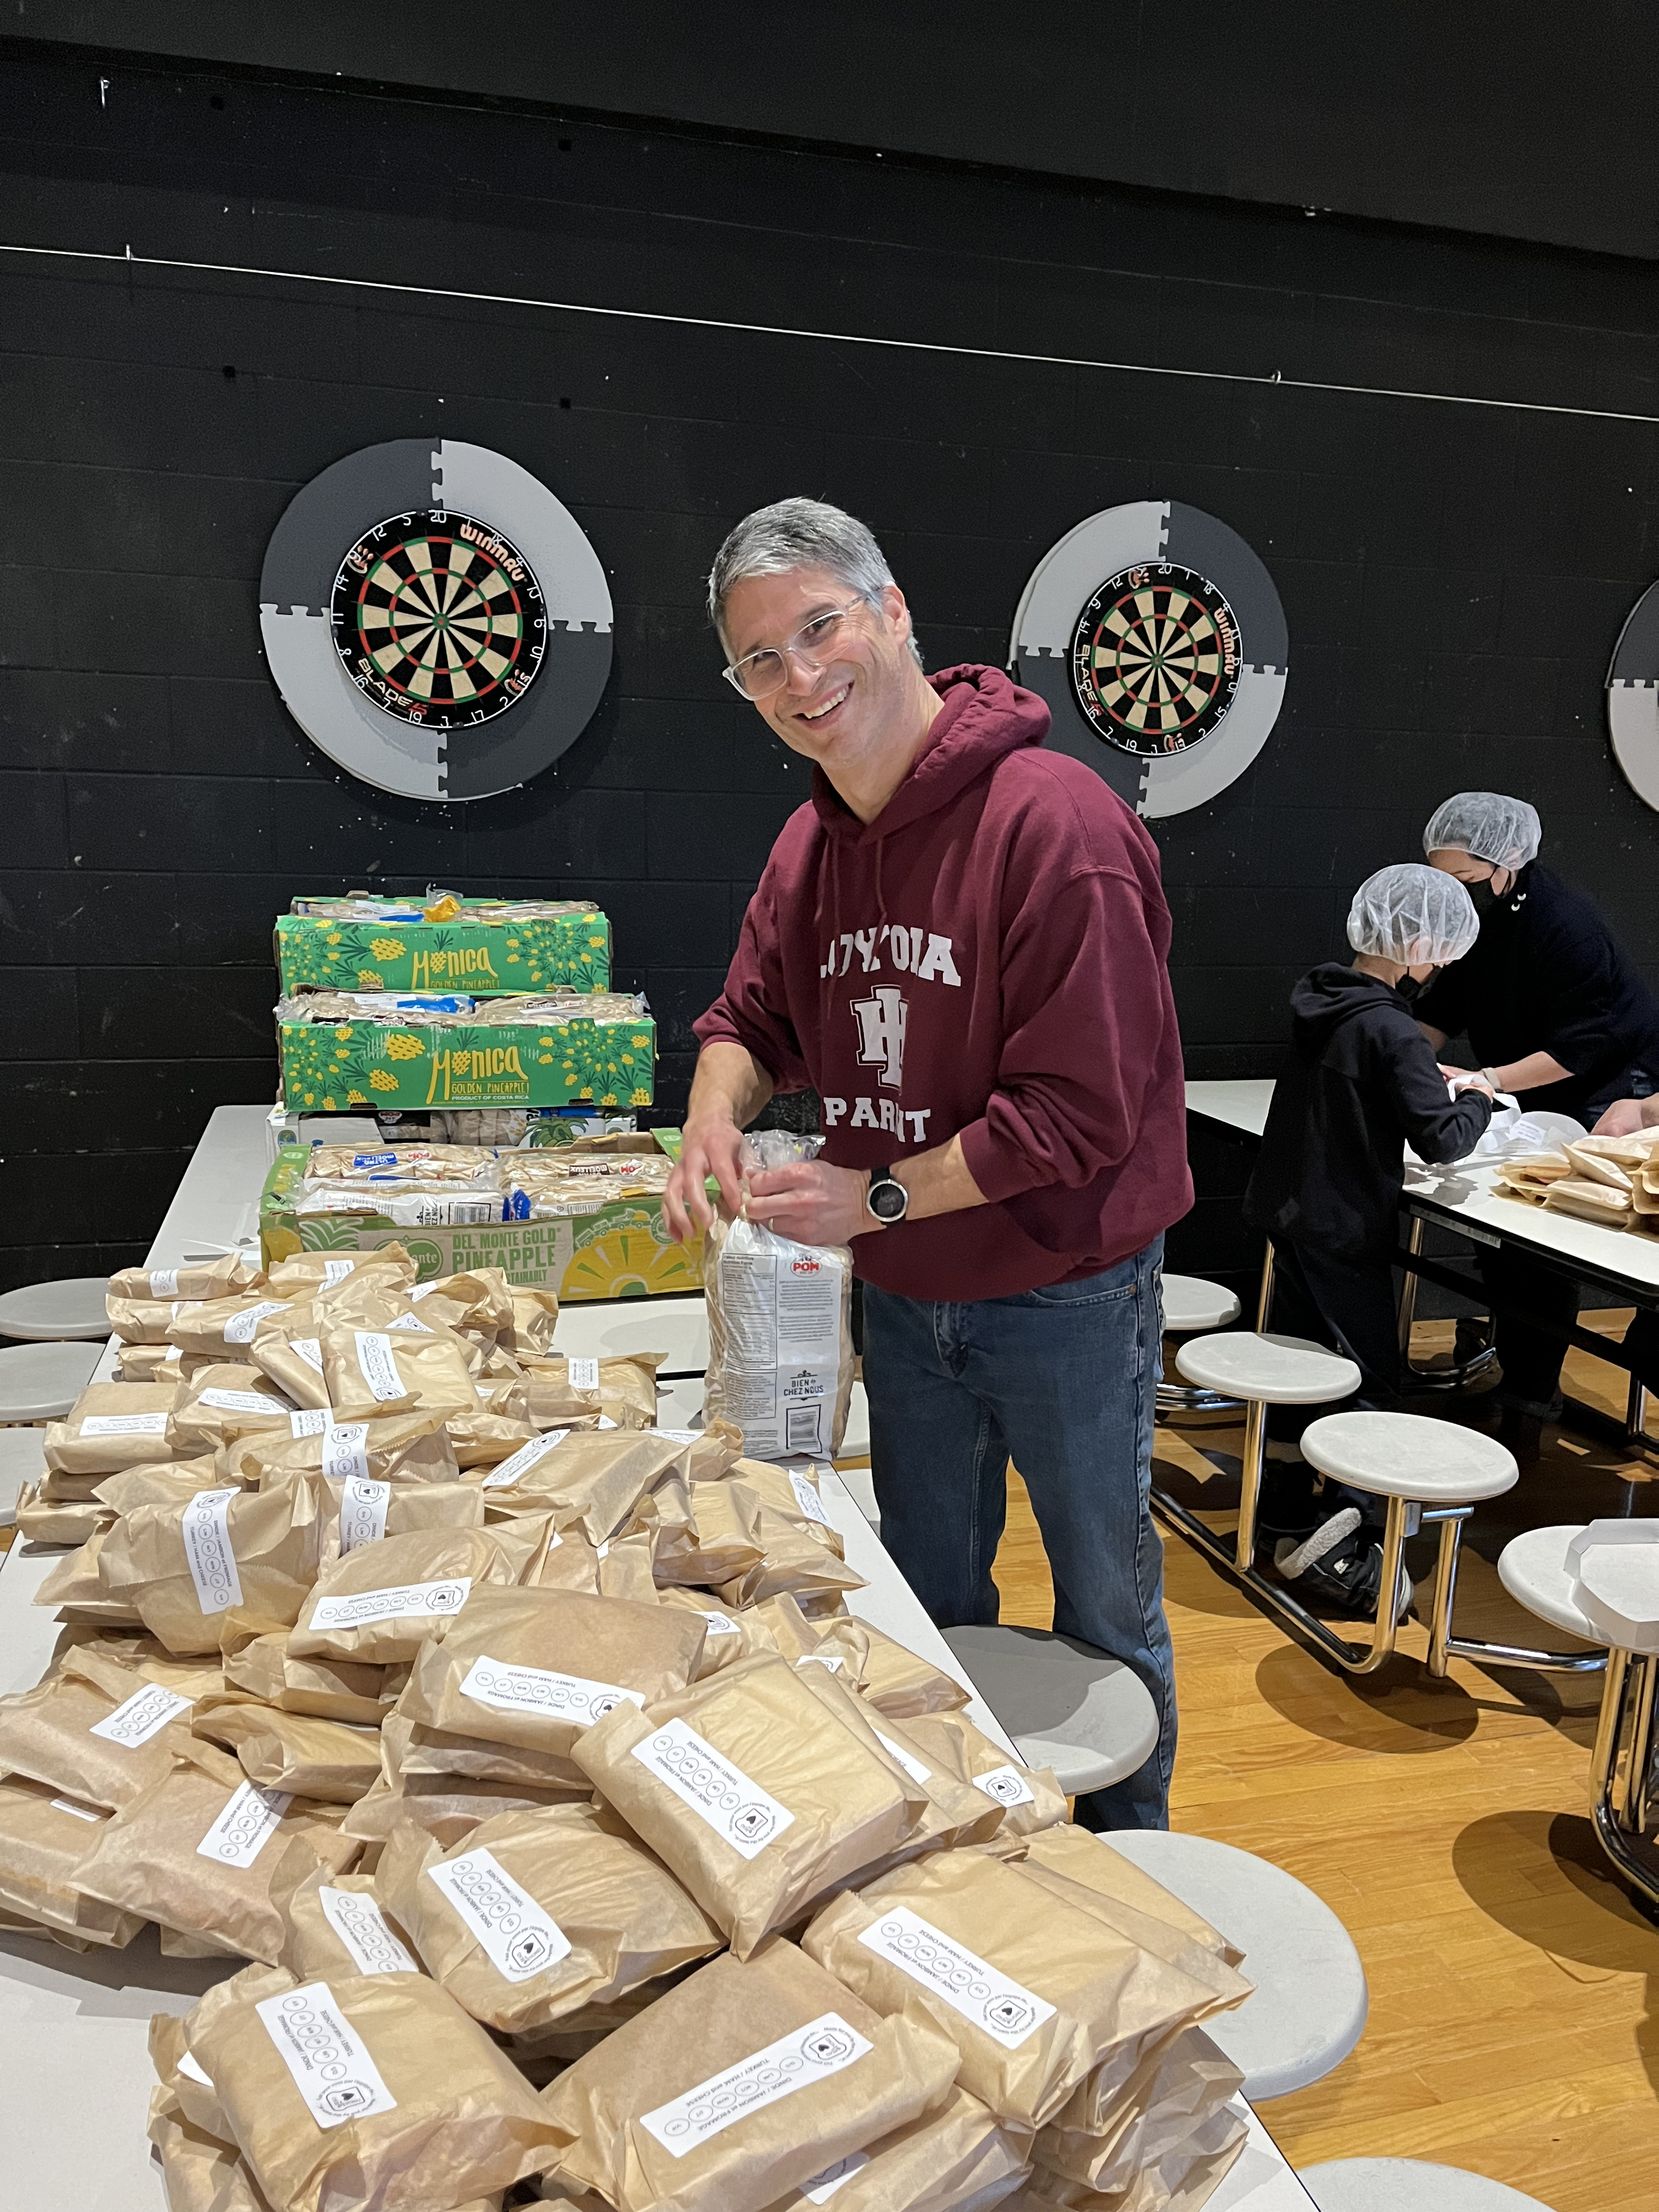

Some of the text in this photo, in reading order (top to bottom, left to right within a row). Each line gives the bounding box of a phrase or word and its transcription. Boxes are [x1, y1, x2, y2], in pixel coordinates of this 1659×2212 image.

[402, 516, 411, 526] 5
[431, 511, 447, 523] 20
[371, 526, 386, 541] 12
[1158, 563, 1172, 574] 20
[1185, 569, 1191, 580] 1
[335, 574, 349, 591] 14
[1110, 577, 1124, 589] 12
[1204, 583, 1215, 595] 18
[1090, 599, 1101, 609] 9
[332, 613, 344, 624] 11
[534, 619, 546, 628] 6
[1079, 620, 1091, 634] 14
[530, 646, 543, 658] 10
[1081, 644, 1098, 702] BLADE
[354, 674, 368, 689] 16
[357, 657, 413, 707] BLADE
[1227, 682, 1237, 692] 10
[382, 699, 391, 709] 7
[500, 697, 509, 707] 2
[408, 711, 422, 723] 19
[471, 710, 484, 723] 17
[1215, 708, 1227, 718] 15
[441, 716, 449, 727] 3
[1106, 726, 1114, 736] 7
[1198, 728, 1206, 737] 2
[1126, 740, 1137, 751] 19
[1151, 744, 1158, 754] 3
[452, 1081, 525, 1094] GOLDEN PINEAPPLE
[823, 1097, 930, 1143] PART
[569, 1164, 608, 1173] MOELLEUX
[452, 1234, 476, 1250] DEL
[480, 1231, 519, 1249] MONTE
[412, 1252, 438, 1264] onte
[452, 1245, 556, 1273] PINEAPPLE
[793, 1262, 820, 1271] POM
[506, 1269, 548, 1285] STAINABLY
[792, 1379, 810, 1387] BIEN
[783, 1385, 823, 1396] CHEZ NOUS
